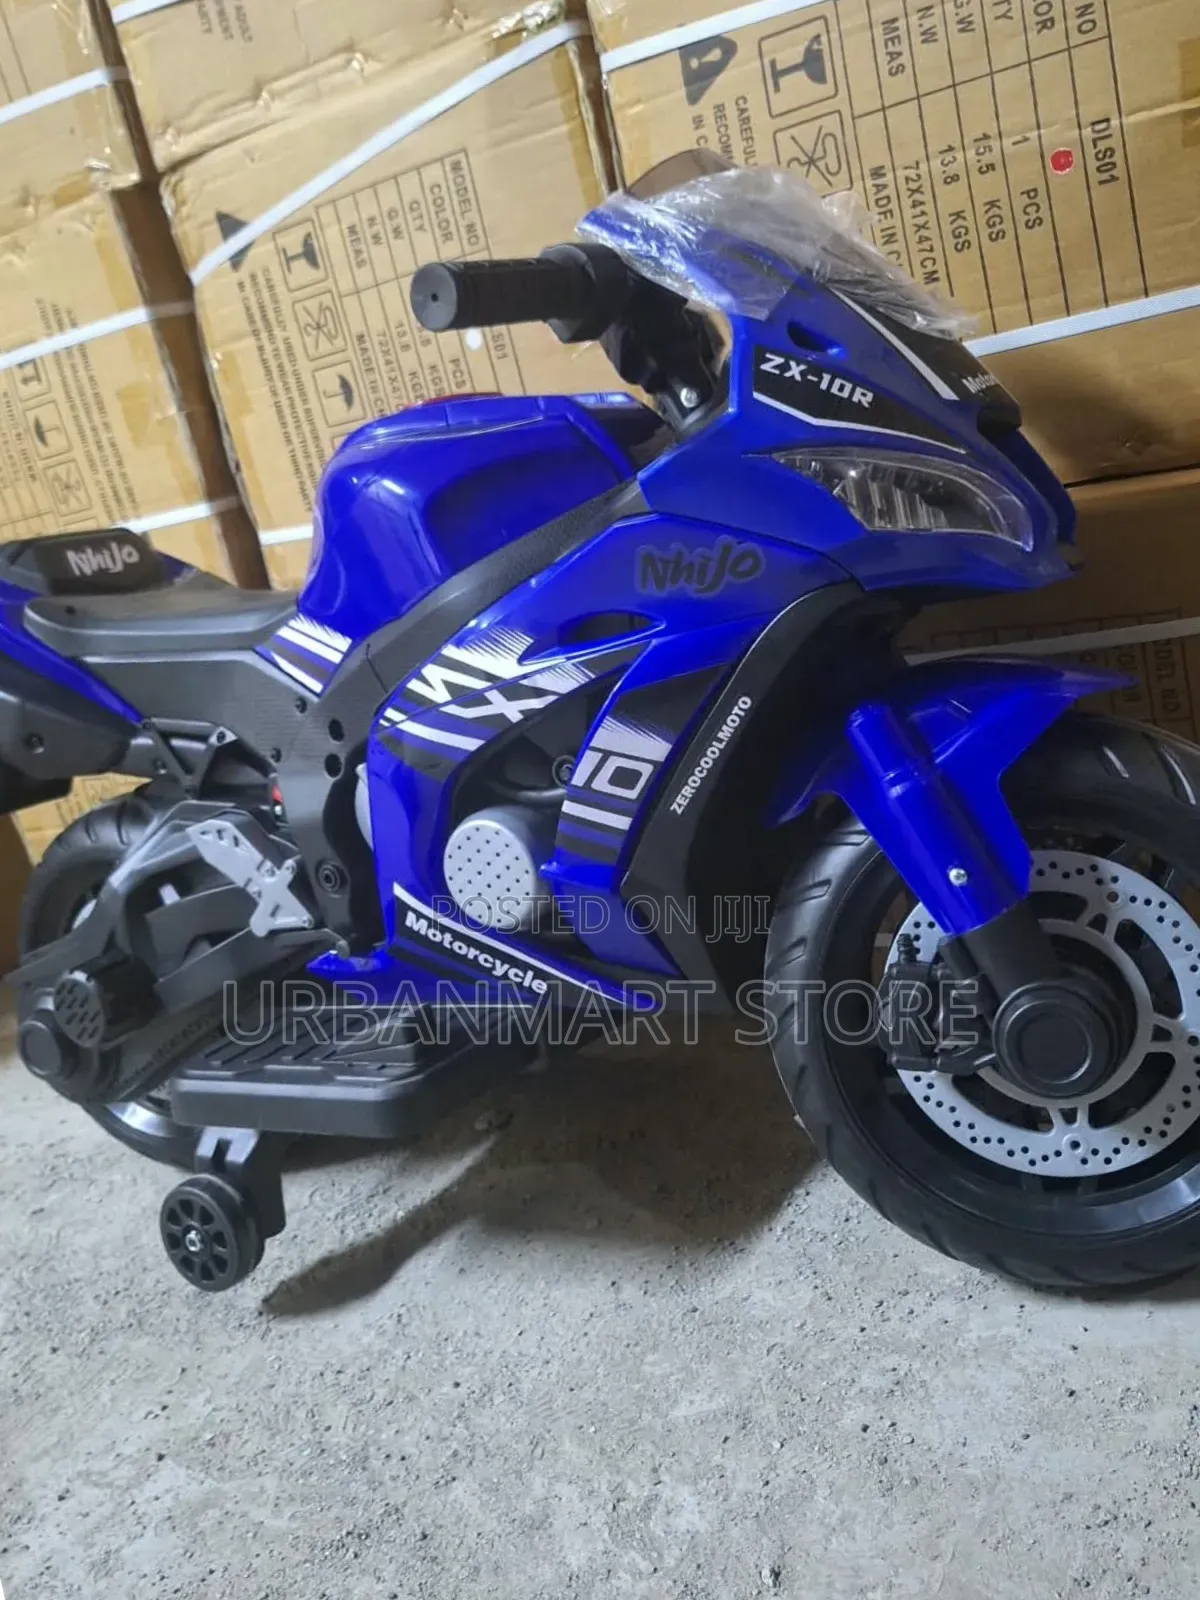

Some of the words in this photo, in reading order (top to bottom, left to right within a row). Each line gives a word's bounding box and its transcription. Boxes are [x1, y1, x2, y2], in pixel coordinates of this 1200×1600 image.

[916, 4, 938, 45] N.W
[1033, 0, 1055, 36] OR
[1074, 2, 1098, 35] NO
[881, 17, 905, 77] MEAS
[973, 132, 996, 175] 15.5
[1091, 117, 1119, 186] DLS01
[409, 200, 426, 233] QTY
[430, 184, 453, 244] COLOR
[450, 160, 472, 219] MODEL
[465, 222, 480, 246] NO
[869, 165, 894, 222] MADE
[938, 144, 960, 186] 13.8
[949, 210, 971, 253] KGS
[1020, 187, 1043, 231] PCS
[880, 225, 899, 246] IN
[902, 160, 941, 285] 72X41X47CM
[983, 198, 1006, 243] KGS
[347, 224, 367, 269] MEAS
[449, 358, 466, 389] PCS
[760, 352, 875, 408] ZX-10R
[670, 696, 752, 815] ZEROCOOLMOTO
[405, 910, 548, 995] Motorcycle
